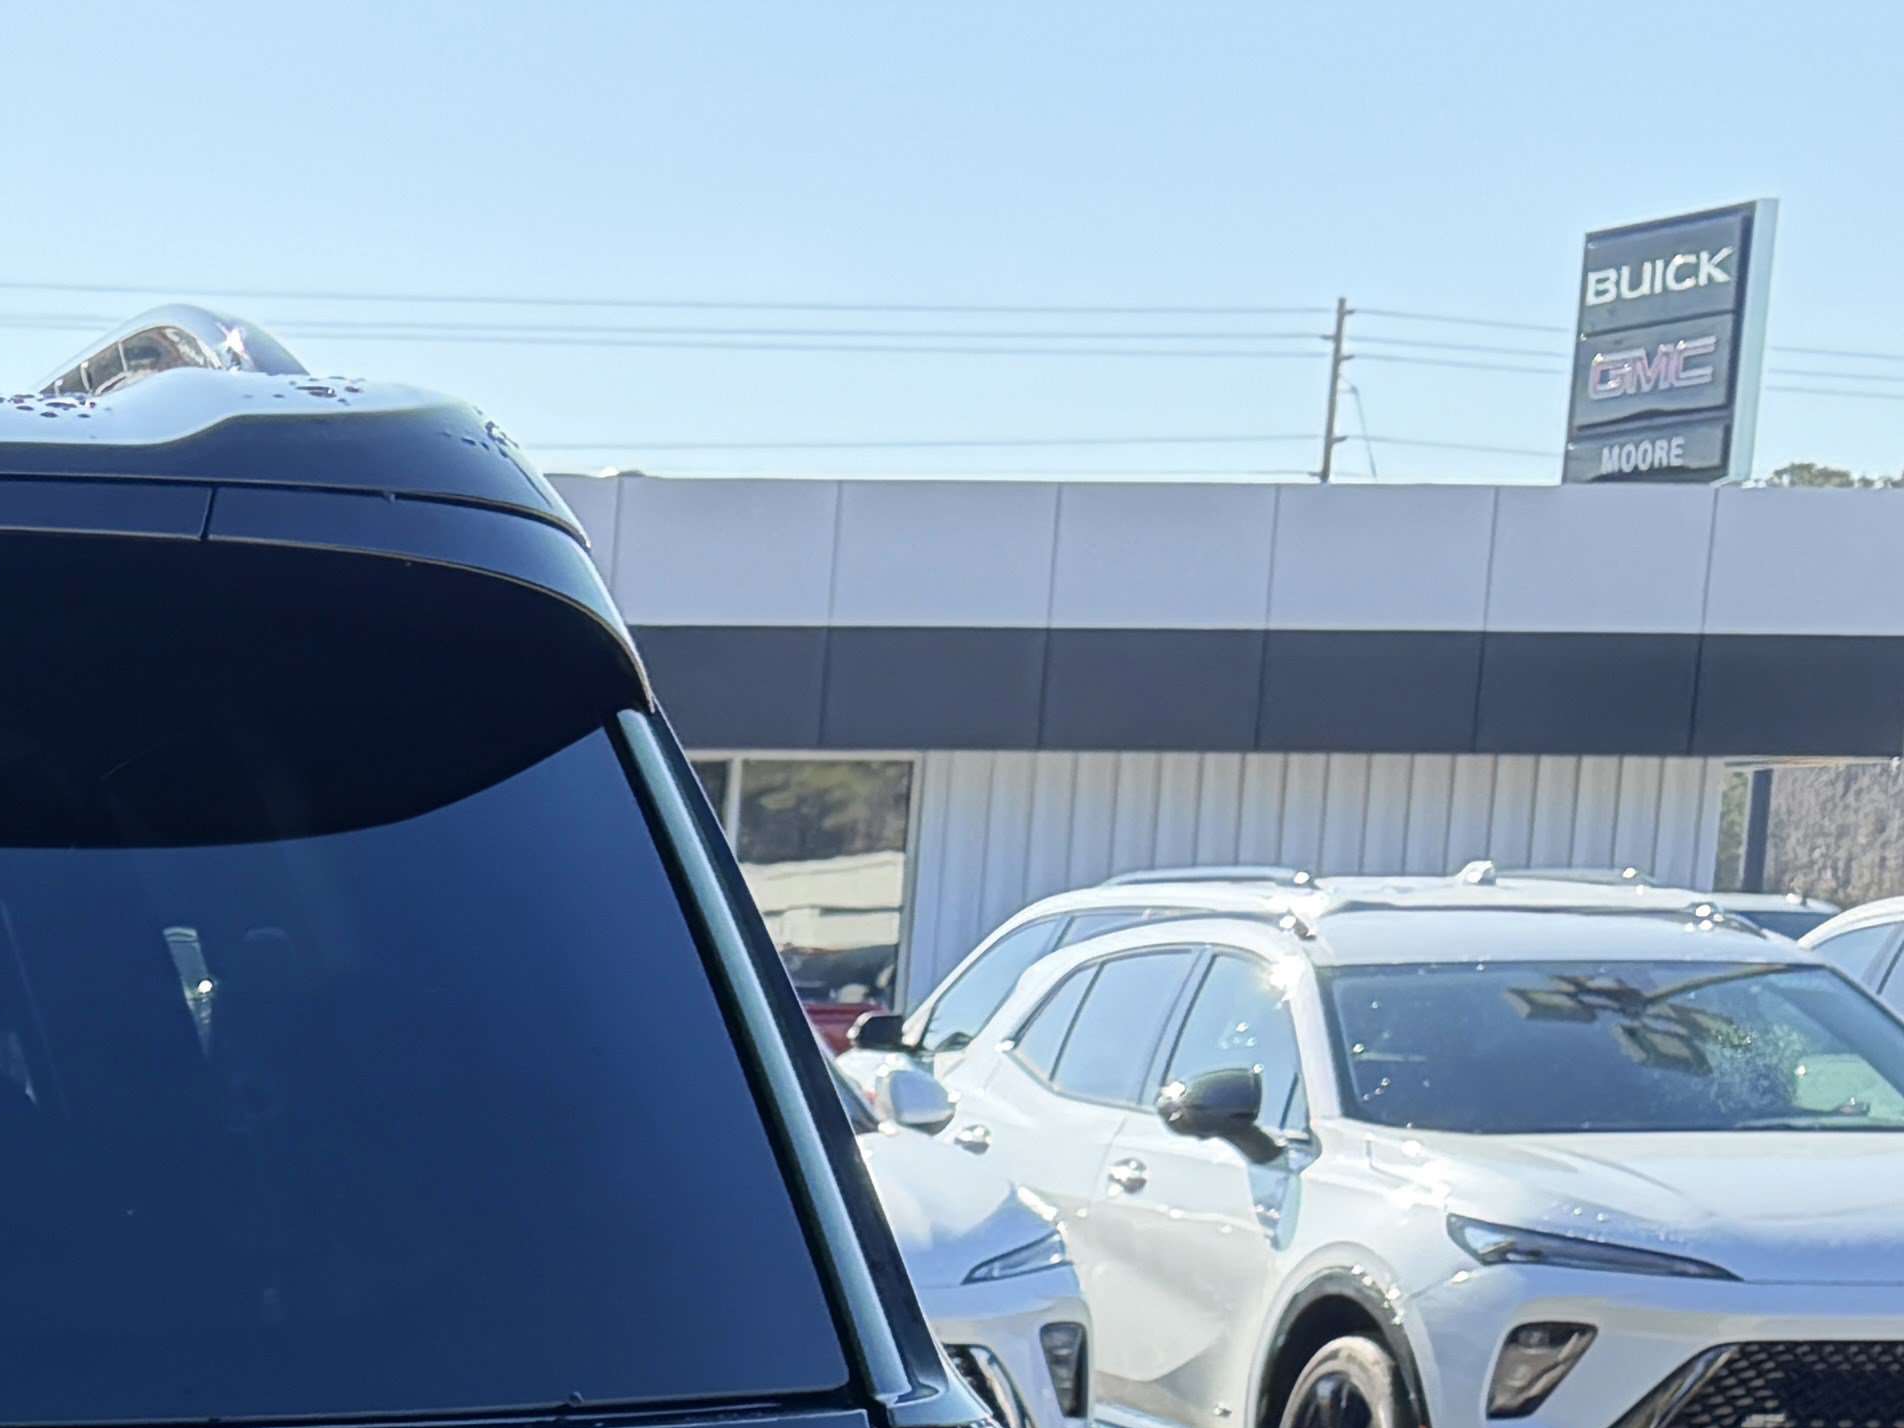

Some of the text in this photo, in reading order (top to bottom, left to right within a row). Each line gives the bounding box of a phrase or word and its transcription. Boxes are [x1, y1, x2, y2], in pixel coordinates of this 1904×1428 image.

[1585, 245, 1734, 306] BUICK
[1588, 335, 1716, 401] GMC
[1600, 436, 1685, 475] MOORE
